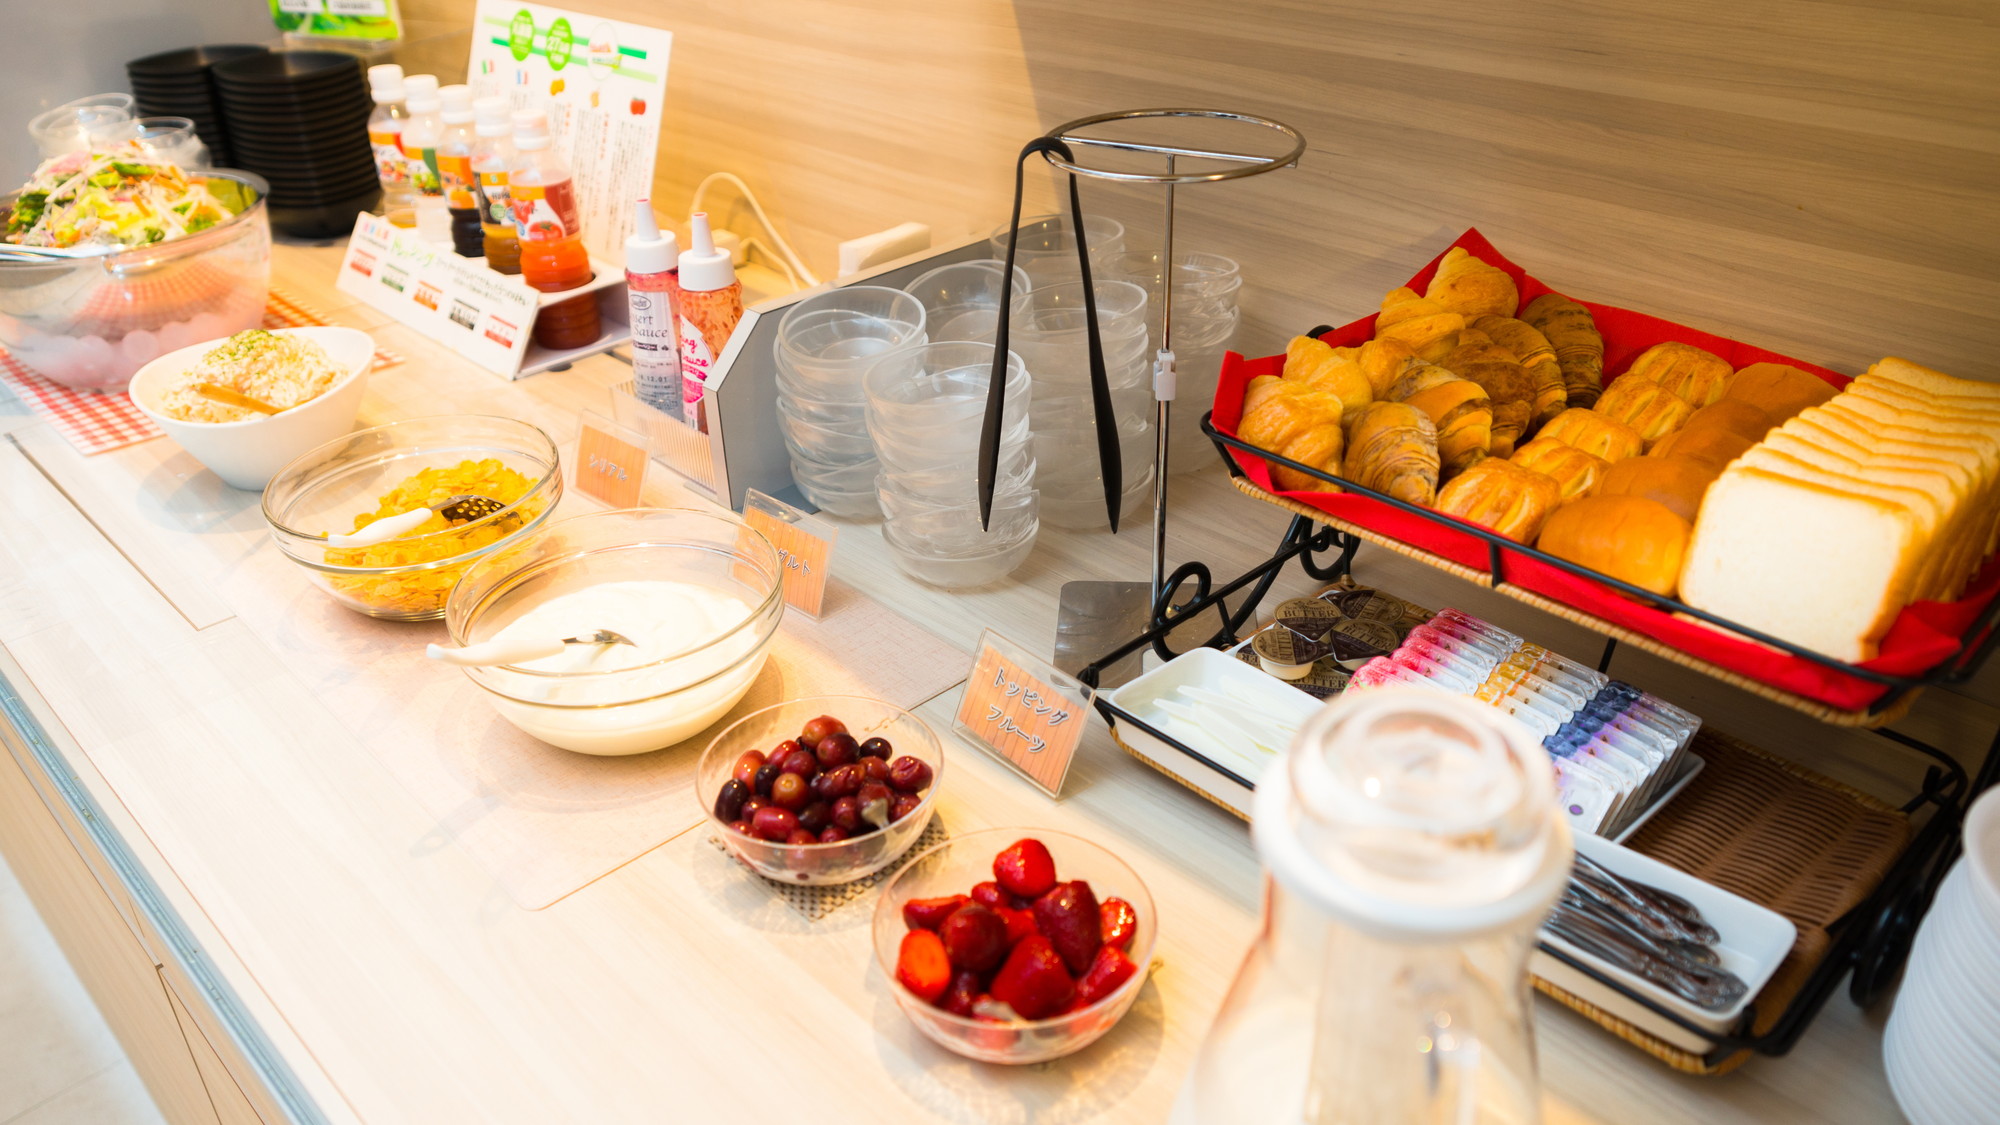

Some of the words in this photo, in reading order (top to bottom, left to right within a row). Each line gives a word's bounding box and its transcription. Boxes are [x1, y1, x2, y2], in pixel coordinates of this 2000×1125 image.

[683, 355, 709, 367] auce
[589, 453, 628, 481] シリアル
[777, 548, 810, 577] グルト
[1283, 609, 1335, 618] BUTTER
[1341, 625, 1392, 650] BUTTER
[994, 668, 1069, 727] トッピング
[986, 704, 1047, 753] フルーツ
